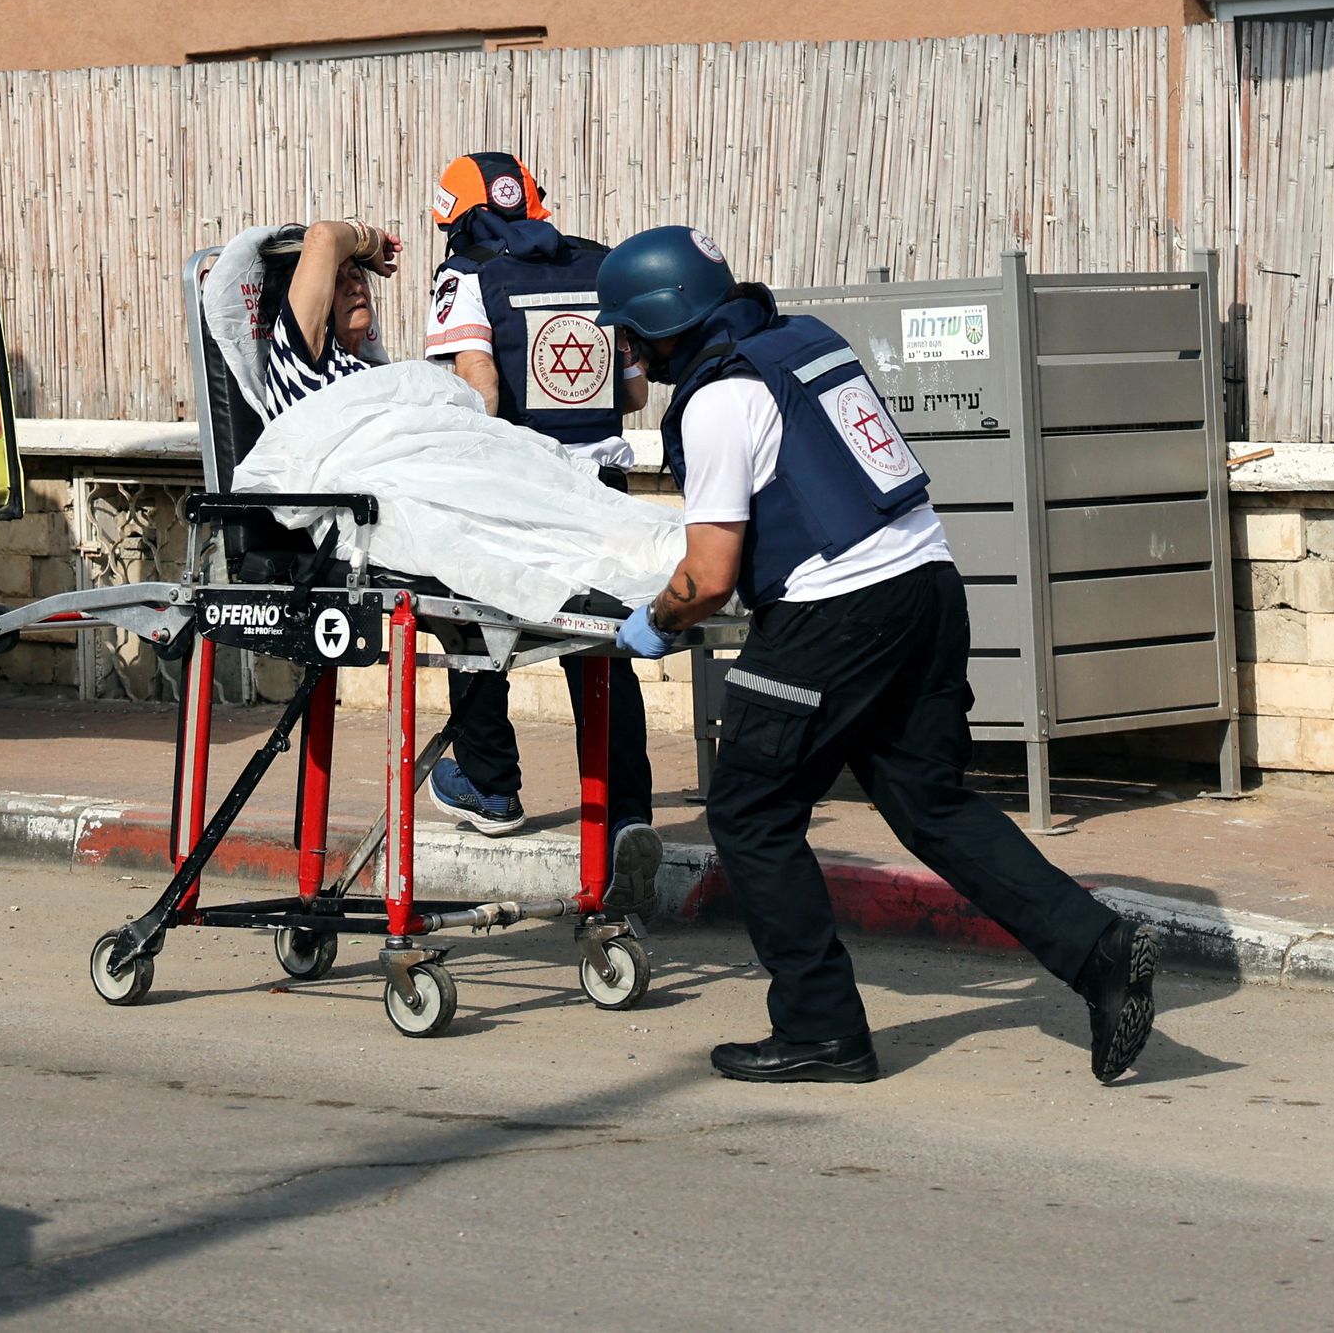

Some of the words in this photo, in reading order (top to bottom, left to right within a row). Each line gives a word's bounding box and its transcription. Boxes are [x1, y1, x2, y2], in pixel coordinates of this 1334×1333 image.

[538, 354, 550, 383] MAGEN
[548, 381, 568, 397] DAVID
[569, 386, 591, 398] ADOM
[923, 393, 980, 412] עיריית
[220, 604, 280, 626] FERNO
